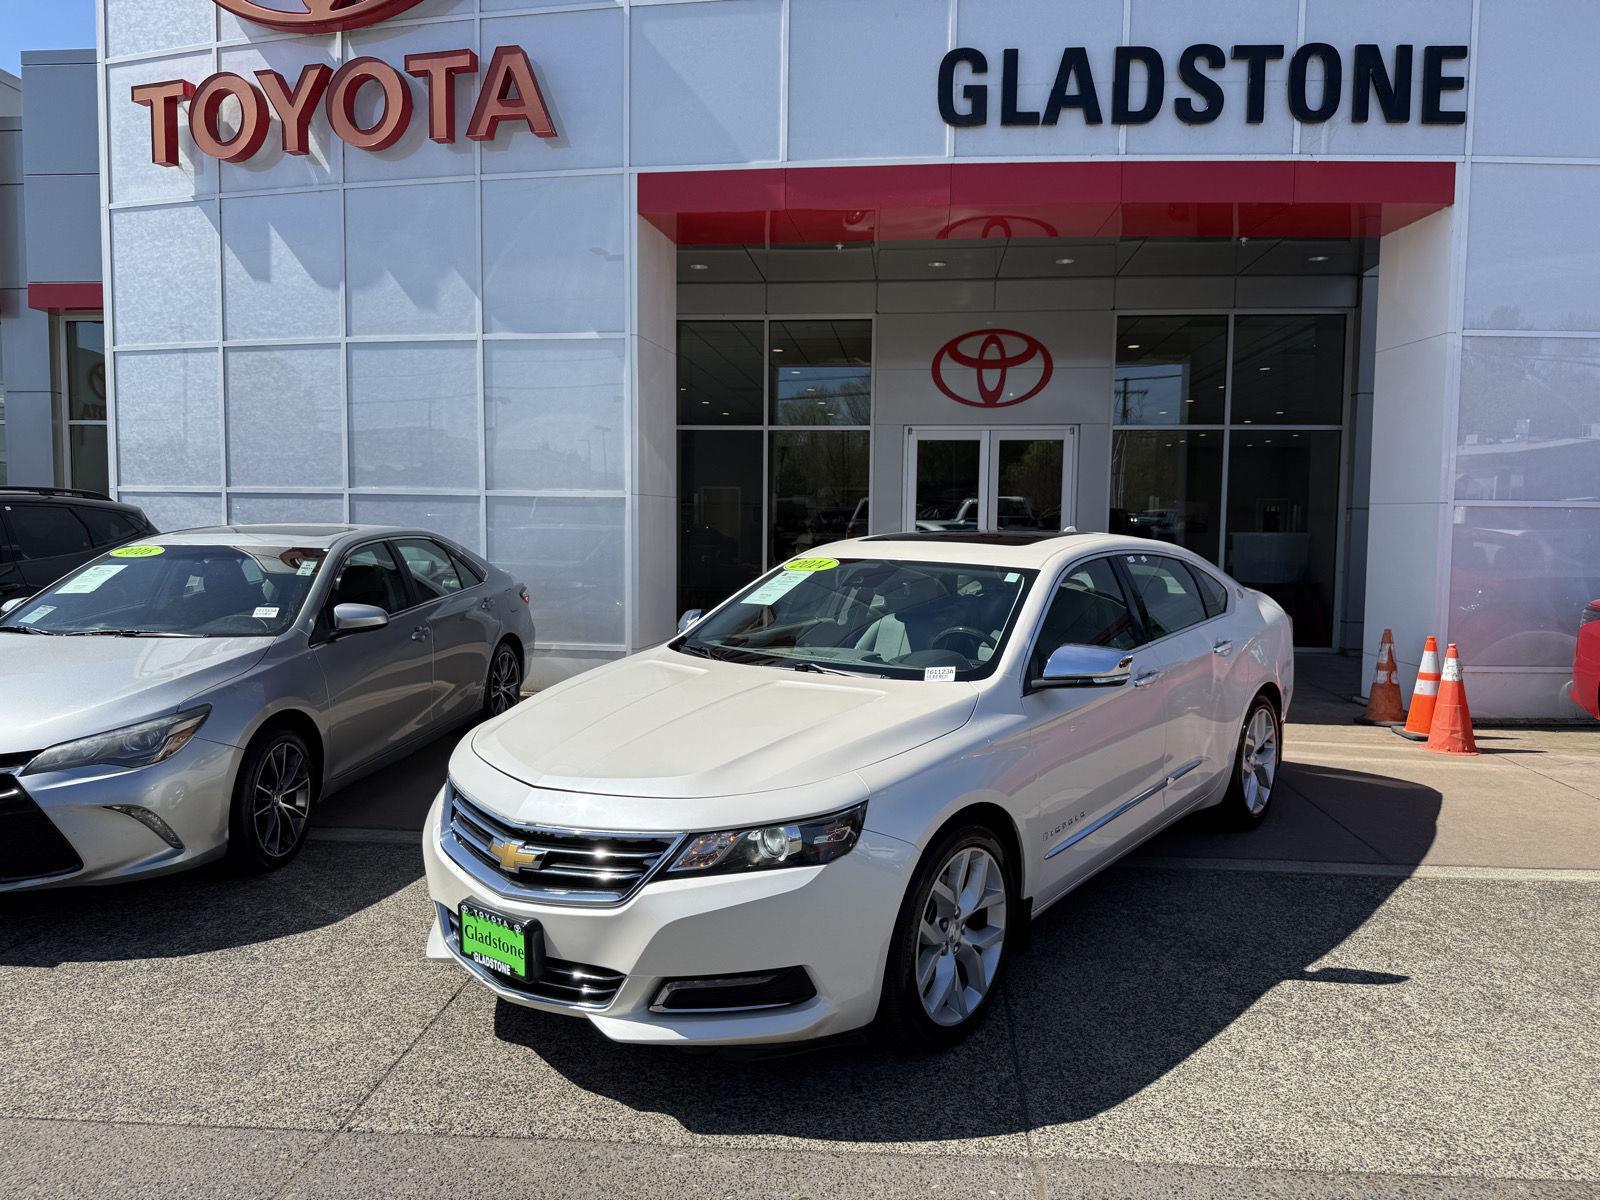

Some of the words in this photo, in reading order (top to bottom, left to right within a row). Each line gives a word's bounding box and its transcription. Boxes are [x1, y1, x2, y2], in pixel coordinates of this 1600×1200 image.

[938, 42, 1468, 127] GLADSTONE
[131, 45, 558, 167] TOYOTA
[473, 909, 509, 928] TOYOTA
[464, 924, 525, 960] Gladstone
[473, 952, 511, 976] GLADSTONE
